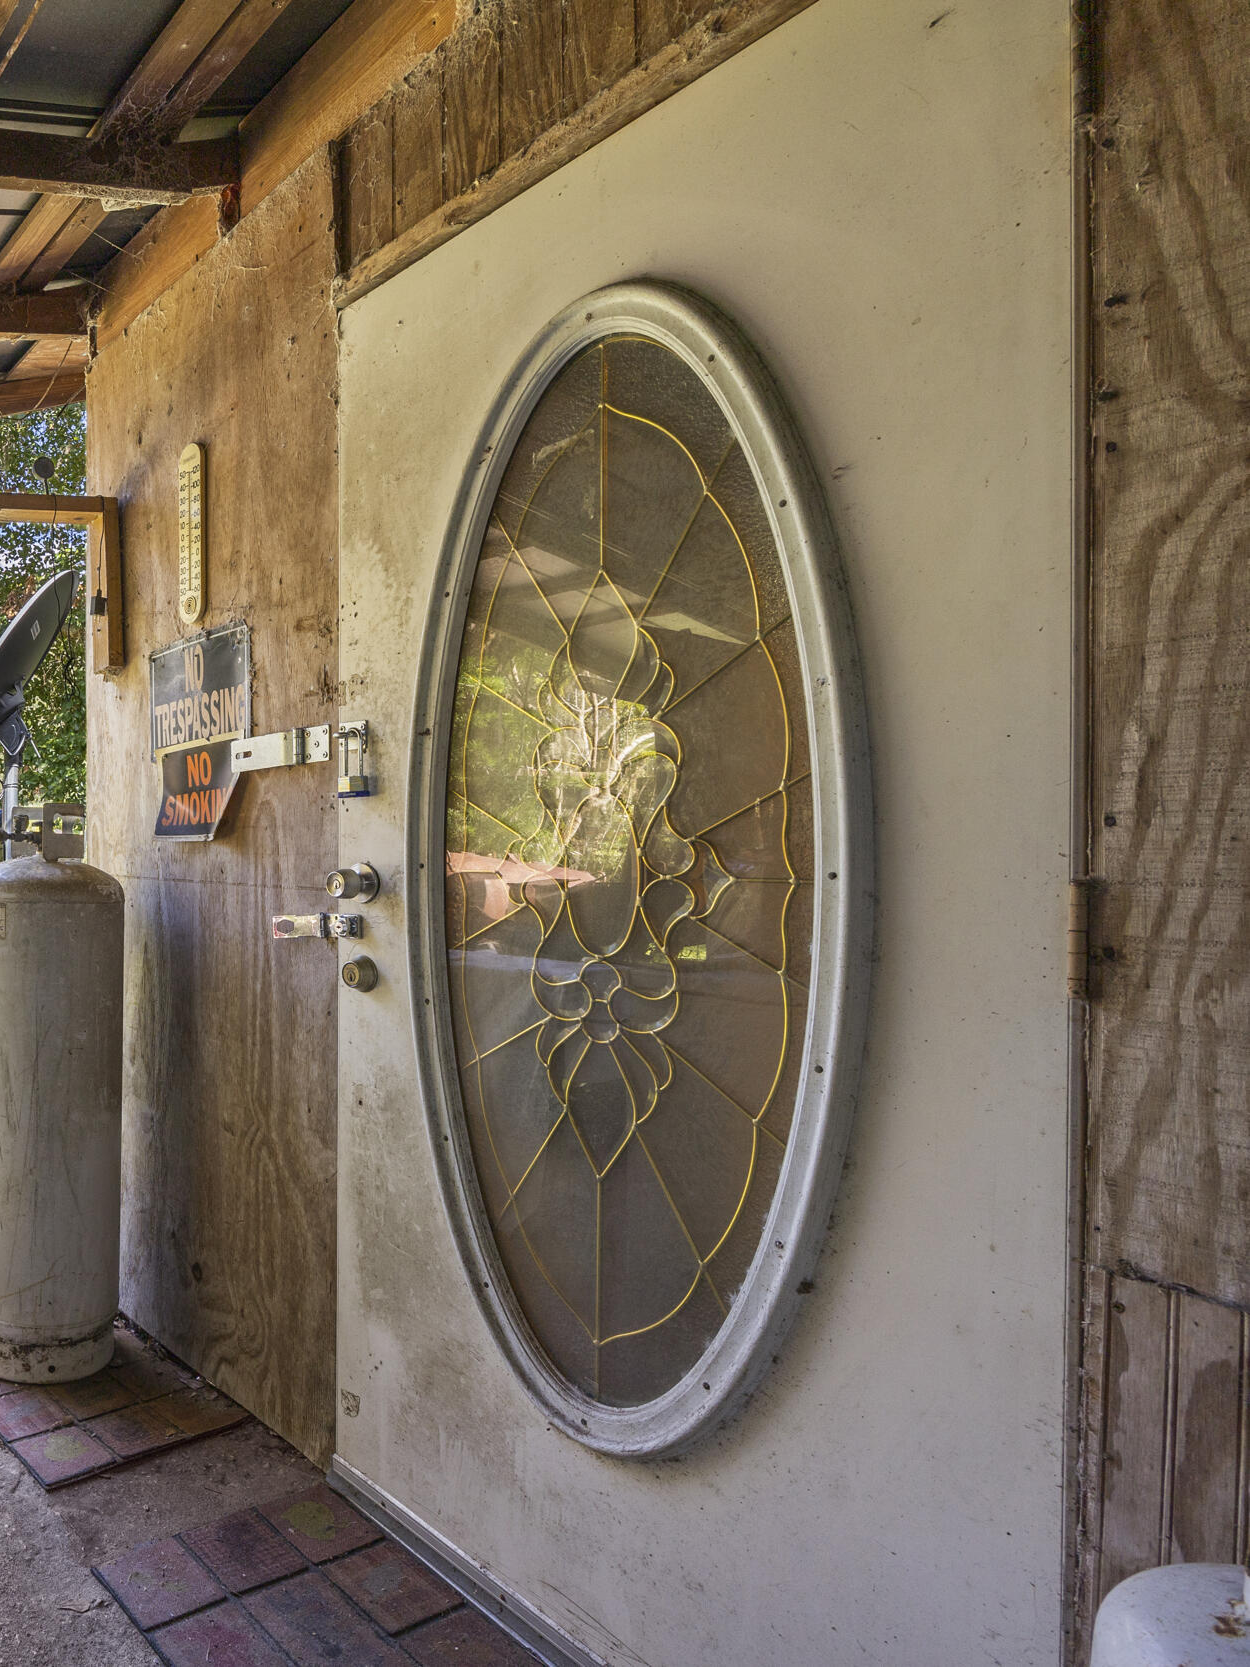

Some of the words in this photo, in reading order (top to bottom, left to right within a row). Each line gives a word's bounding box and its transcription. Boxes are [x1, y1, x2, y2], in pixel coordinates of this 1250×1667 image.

[184, 643, 205, 693] NO
[155, 683, 246, 748] TRESPASSING
[186, 751, 212, 788] NO
[161, 785, 234, 827] SMOKIN
